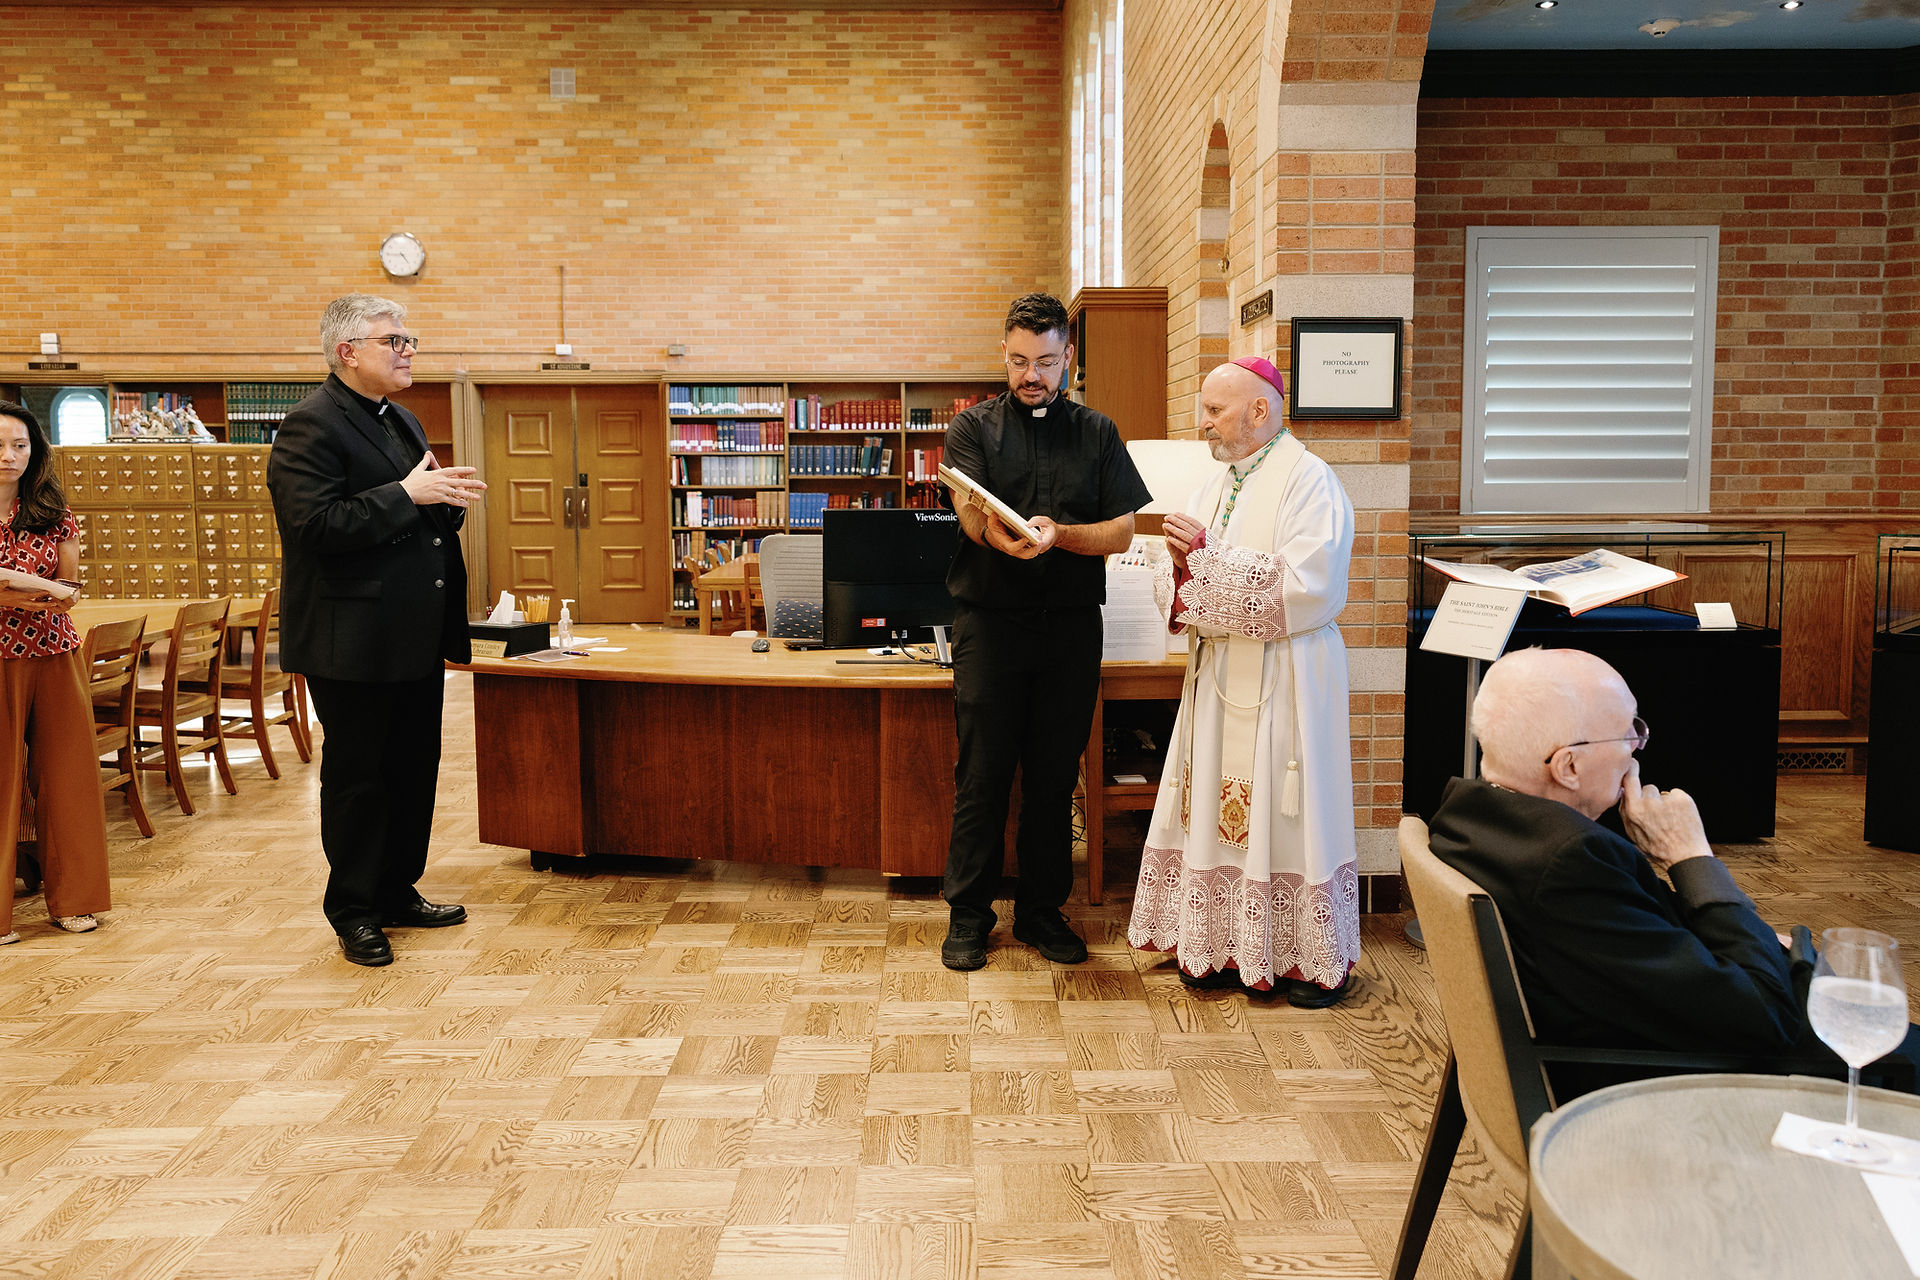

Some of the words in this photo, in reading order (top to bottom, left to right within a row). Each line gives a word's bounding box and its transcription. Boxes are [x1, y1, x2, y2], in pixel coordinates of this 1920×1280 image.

[915, 513, 957, 521] ViewSonic
[1460, 600, 1475, 608] SAINT
[1494, 604, 1509, 612] BIBLE
